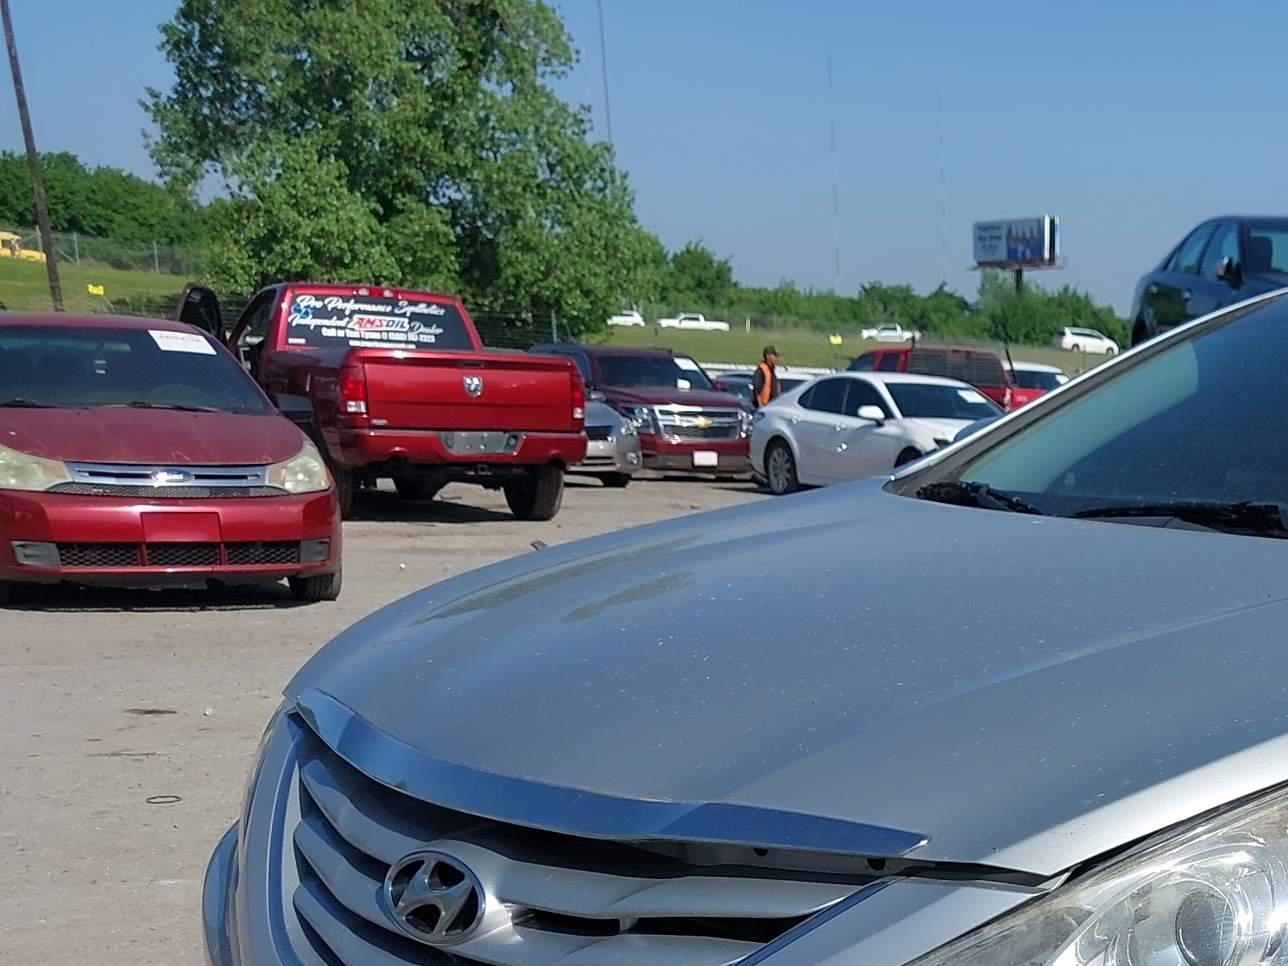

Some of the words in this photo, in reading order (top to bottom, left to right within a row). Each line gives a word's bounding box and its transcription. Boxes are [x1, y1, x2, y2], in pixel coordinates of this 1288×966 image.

[296, 295, 323, 309] Pro
[324, 297, 392, 316] Performance
[352, 317, 408, 330] AMSOIL
